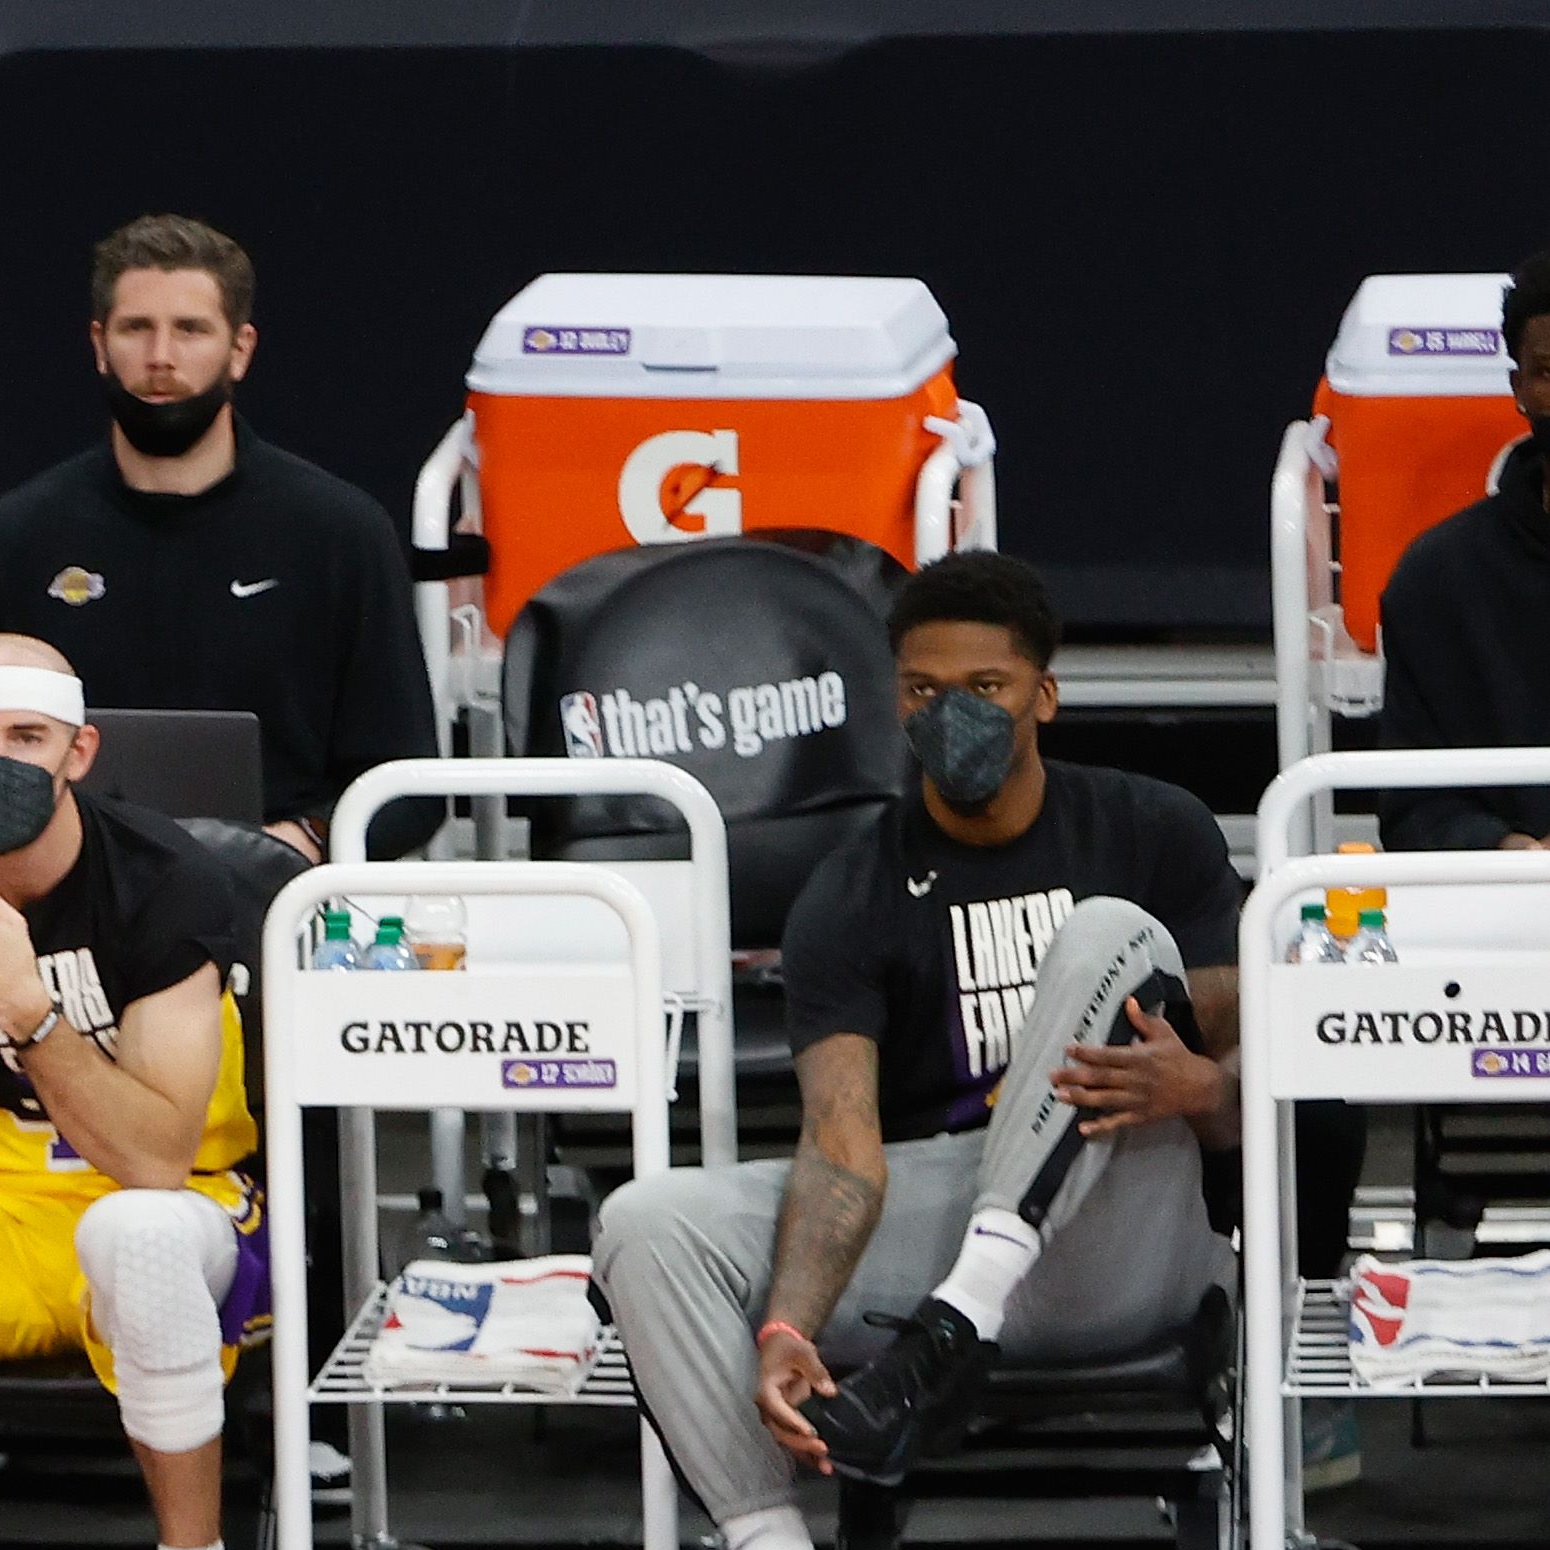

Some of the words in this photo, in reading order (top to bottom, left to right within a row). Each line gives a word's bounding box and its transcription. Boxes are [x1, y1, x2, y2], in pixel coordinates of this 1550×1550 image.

[618, 429, 742, 546] G
[601, 681, 727, 757] that's
[728, 671, 846, 757] game
[340, 1021, 590, 1053] GATORADE
[1316, 1010, 1550, 1044] GATORAD
